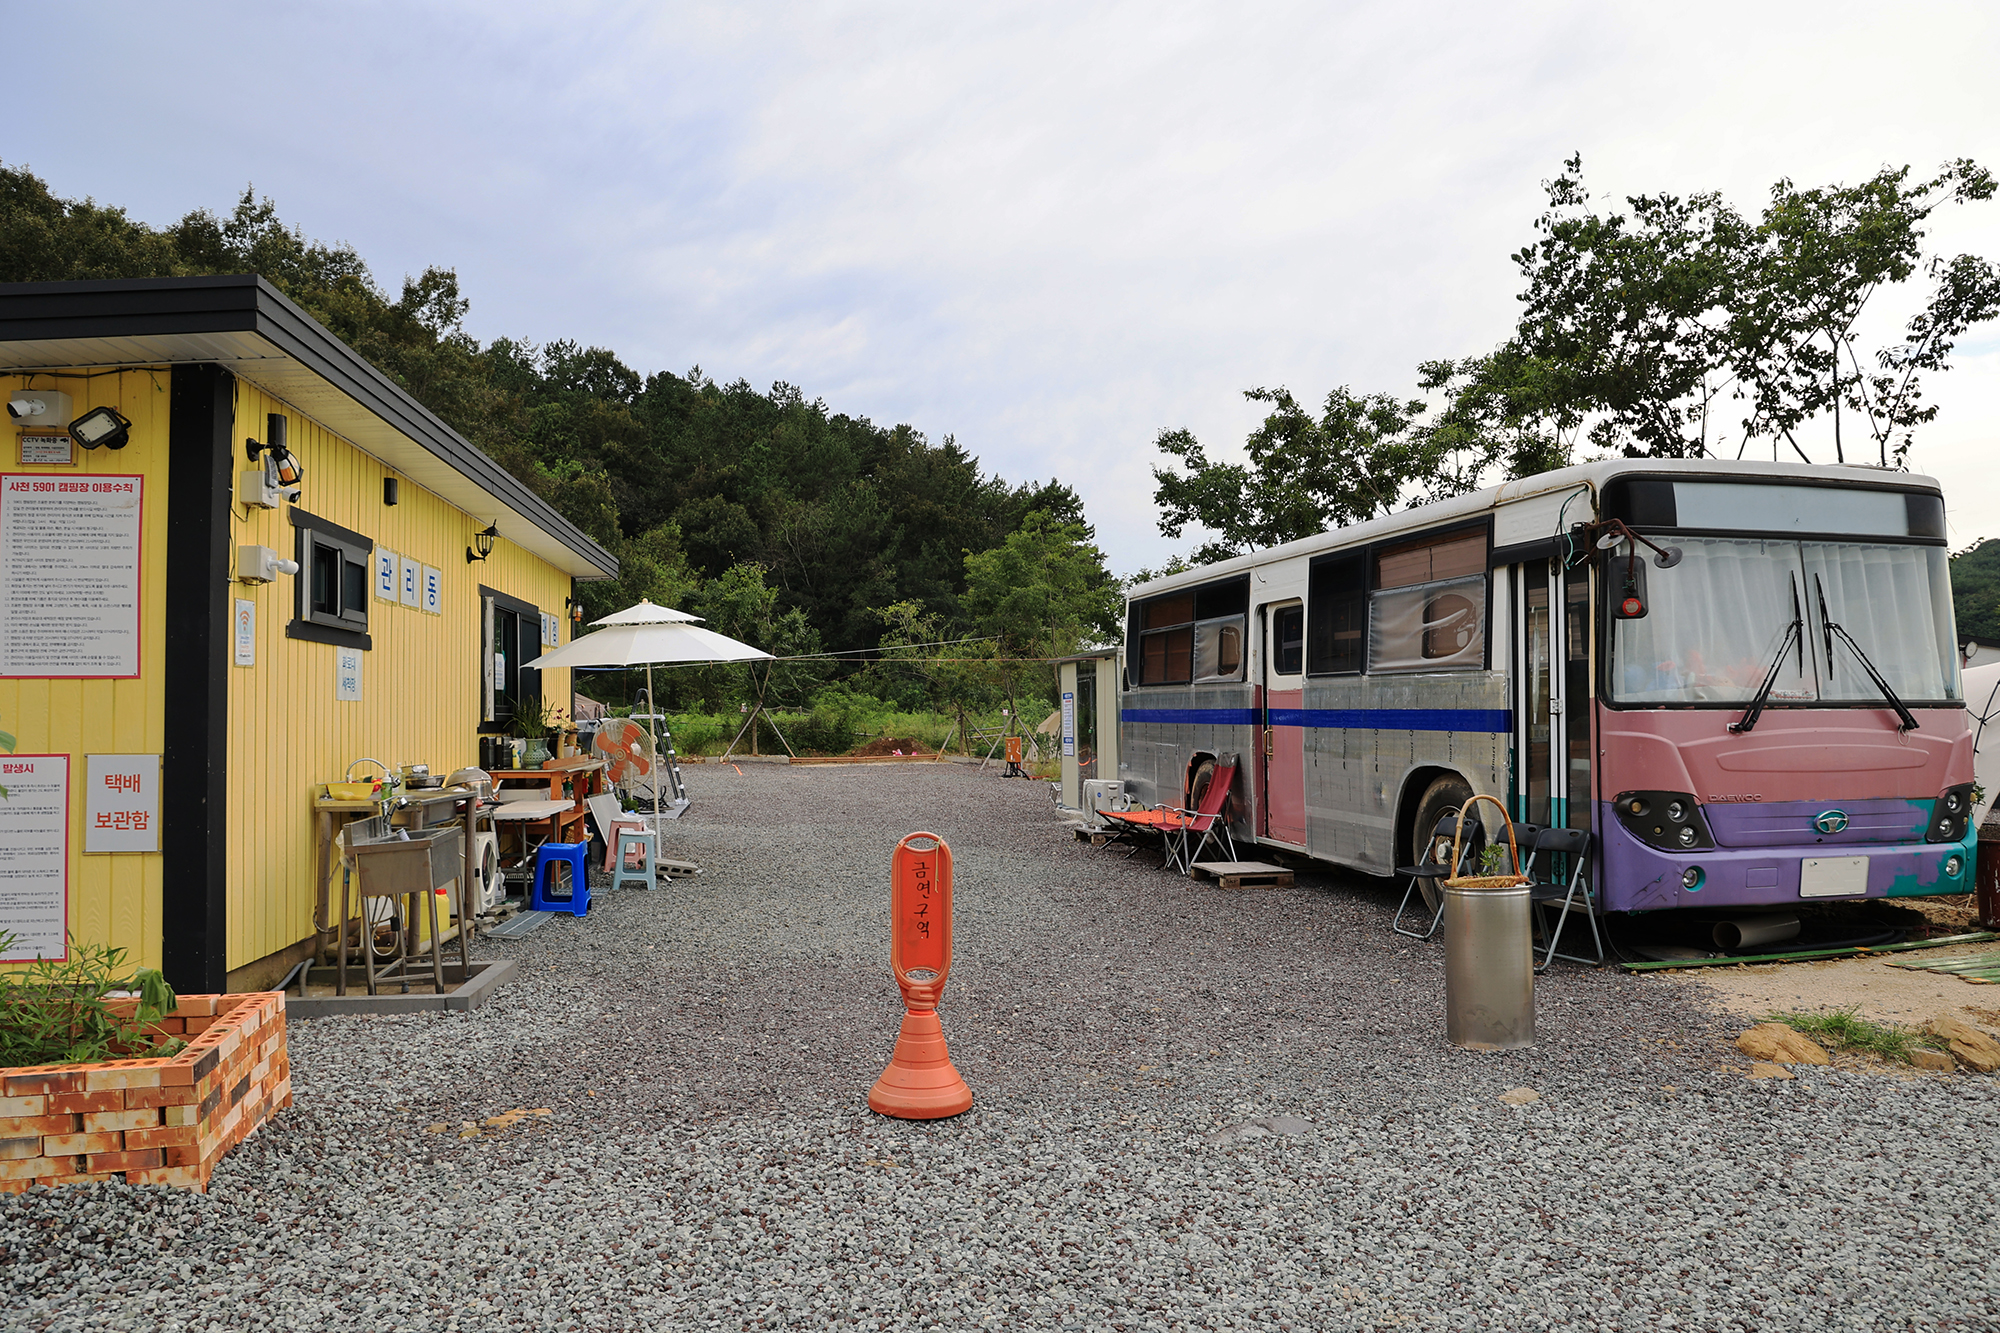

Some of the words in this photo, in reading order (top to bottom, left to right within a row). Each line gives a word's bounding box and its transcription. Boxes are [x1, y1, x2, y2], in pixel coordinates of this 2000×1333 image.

[9, 482, 30, 492] 사천
[32, 482, 55, 493] 5901
[58, 482, 89, 493] 캠핑장
[92, 483, 133, 494] 이용수칙
[381, 557, 437, 606] 관리동
[3, 763, 34, 774] 발생시
[104, 773, 141, 794] 택배
[1708, 793, 1763, 803] DAEWOO
[94, 810, 150, 831] 보관함
[911, 861, 931, 939] 금연구역
